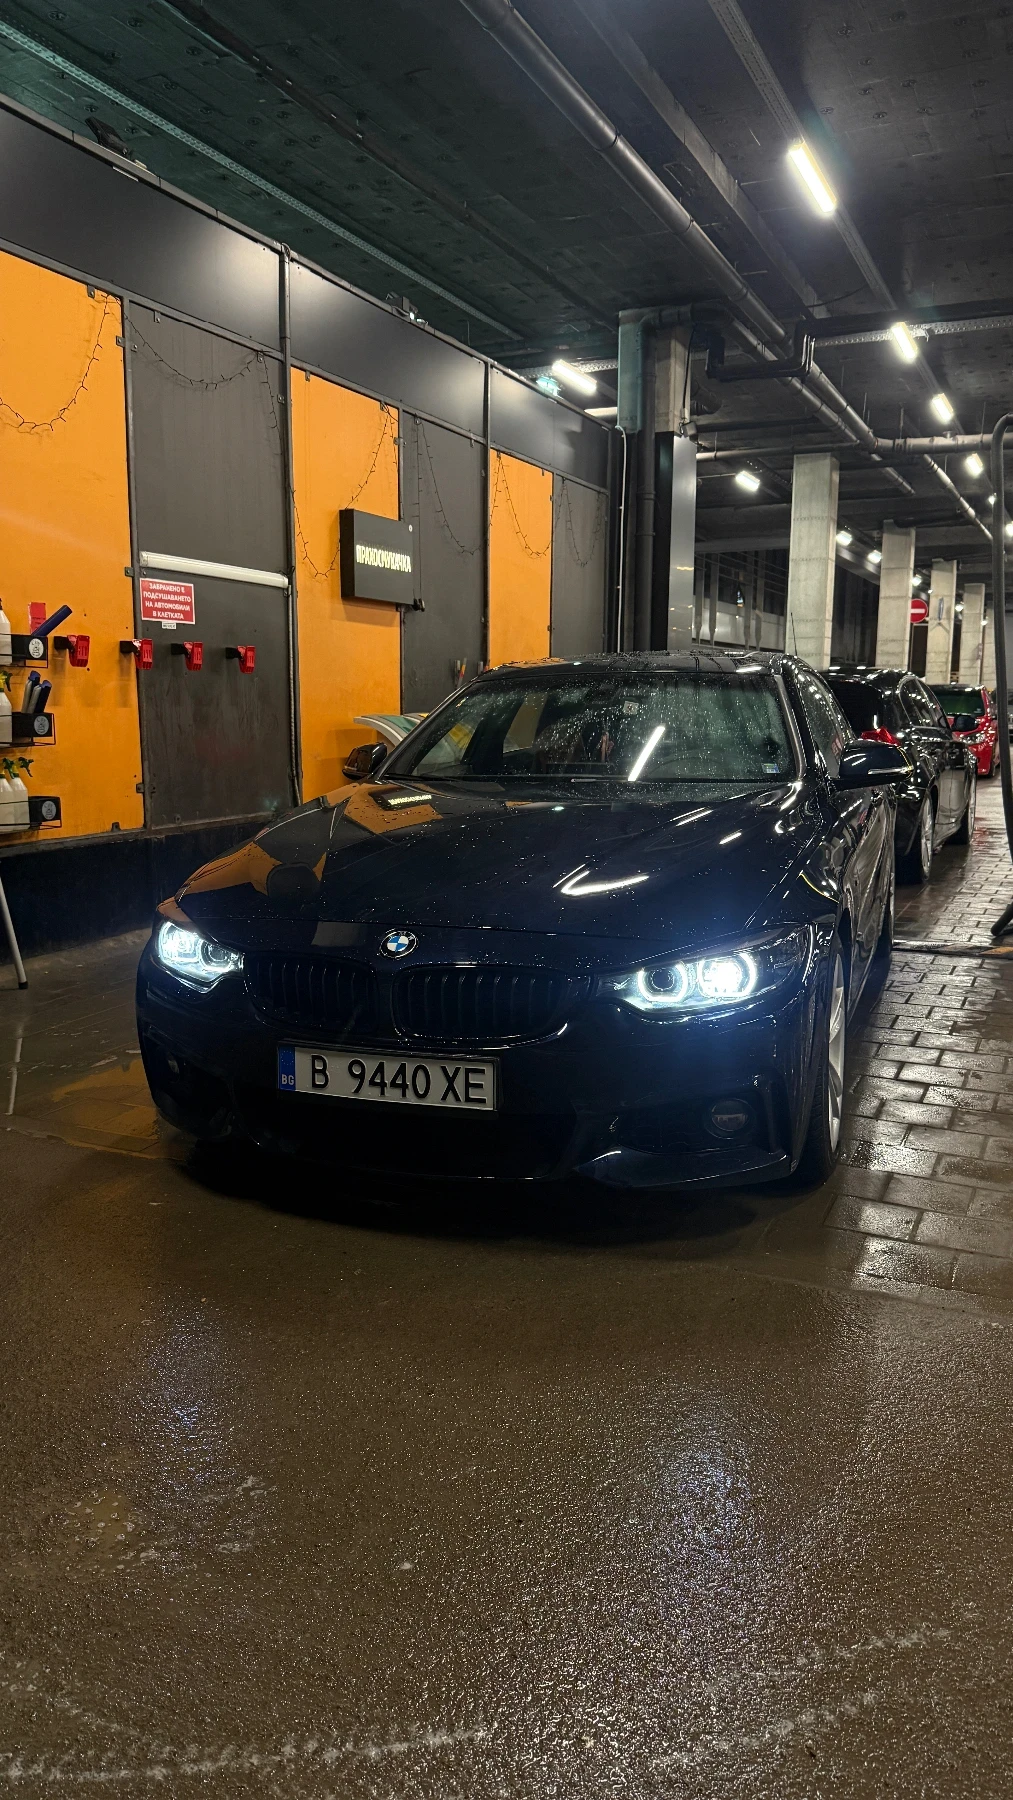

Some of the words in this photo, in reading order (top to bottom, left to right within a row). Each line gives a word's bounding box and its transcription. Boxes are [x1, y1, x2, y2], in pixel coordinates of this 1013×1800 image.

[356, 544, 411, 572] ПРАХОСМУКАЧКА
[149, 583, 180, 592] ЗАБРАНЕНО
[143, 591, 191, 602] ПОДСУШАВАНЕТО
[154, 602, 190, 611] АВТОМОБИЛИ
[157, 611, 184, 619] КЛЕТКАТА
[281, 1073, 295, 1086] BG
[348, 1058, 431, 1099] 9440
